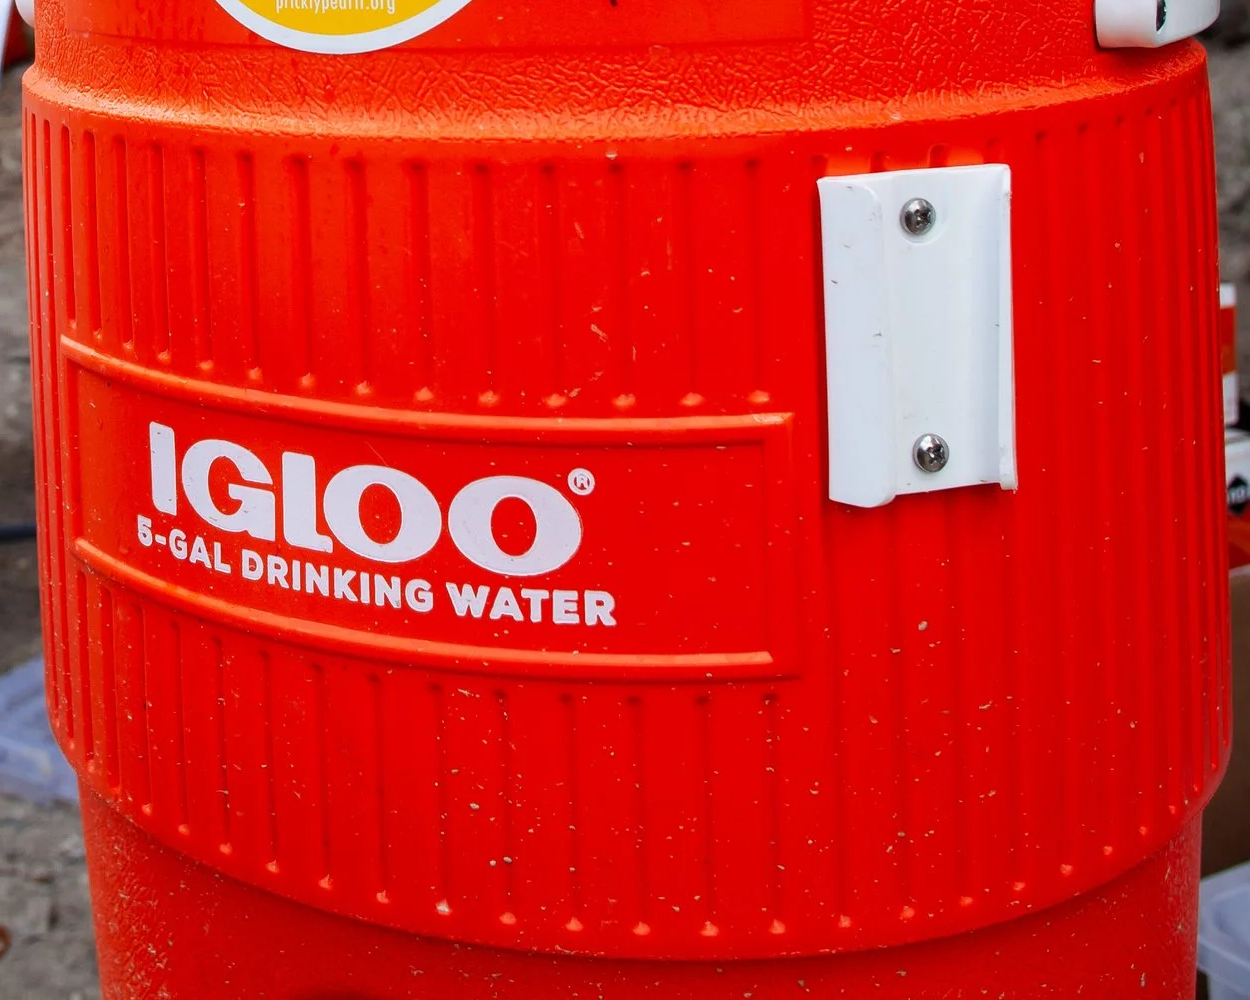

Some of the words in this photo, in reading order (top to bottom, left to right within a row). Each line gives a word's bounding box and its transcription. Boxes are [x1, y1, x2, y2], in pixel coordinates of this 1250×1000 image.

[136, 514, 232, 575] 5-GAL
[241, 549, 434, 613] DRINKING
[445, 581, 617, 627] WATER
